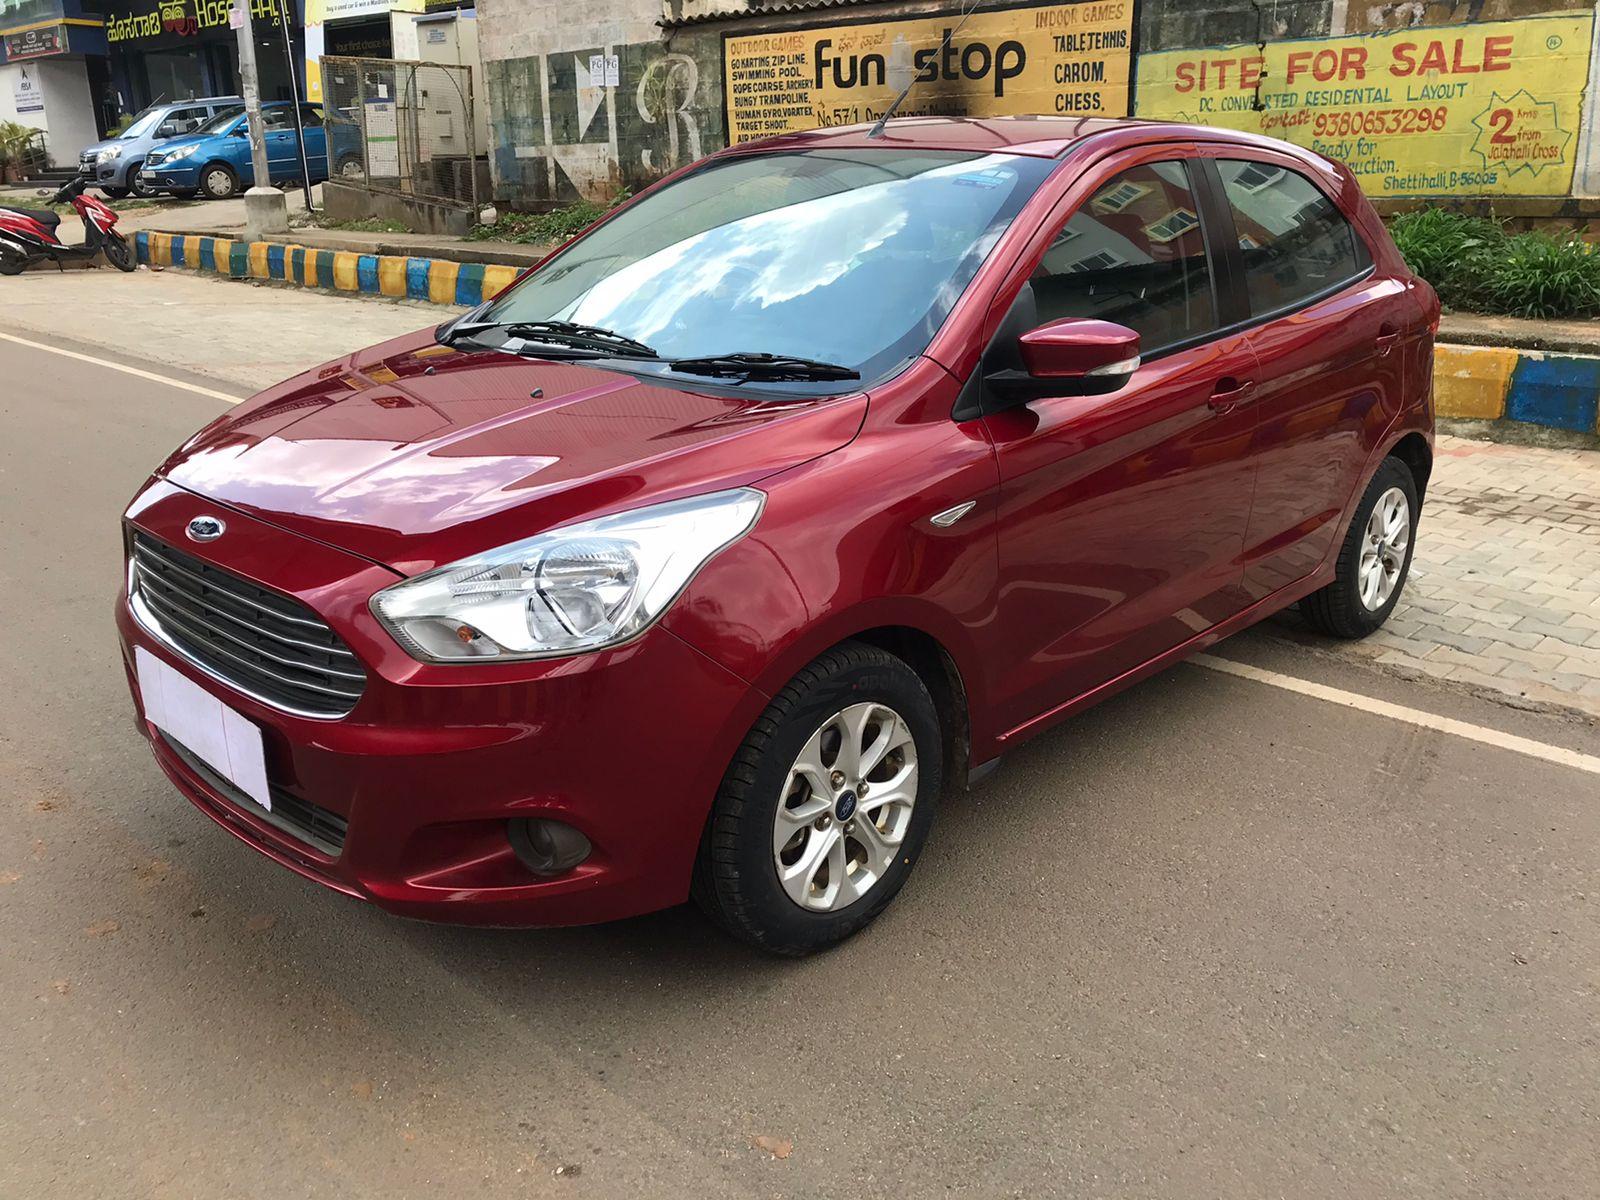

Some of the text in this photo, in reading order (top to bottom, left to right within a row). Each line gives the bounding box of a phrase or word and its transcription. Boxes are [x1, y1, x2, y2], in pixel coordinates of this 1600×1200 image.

[1035, 3, 1125, 29] INDOOR GAMES
[731, 35, 805, 55] OUTDOOR GAMES
[772, 55, 786, 66] ZIP
[913, 27, 1027, 98] stop
[1174, 56, 1266, 93] SITE
[1286, 47, 1368, 85] FOR
[1389, 35, 1515, 77] SALE
[732, 68, 776, 81] SWIMMING
[733, 83, 752, 94] ROPE
[1305, 87, 1393, 107] RESIDENTAL
[1407, 82, 1468, 102] LAYOUT
[735, 96, 758, 107] BUNGY
[735, 109, 761, 120] HUMAN
[1312, 106, 1448, 138] 9380653298
[736, 122, 762, 131] TARGET
[1489, 108, 1517, 144] 2
[1517, 126, 1541, 141] from
[1356, 137, 1378, 157] for
[1532, 142, 1559, 159] Cross
